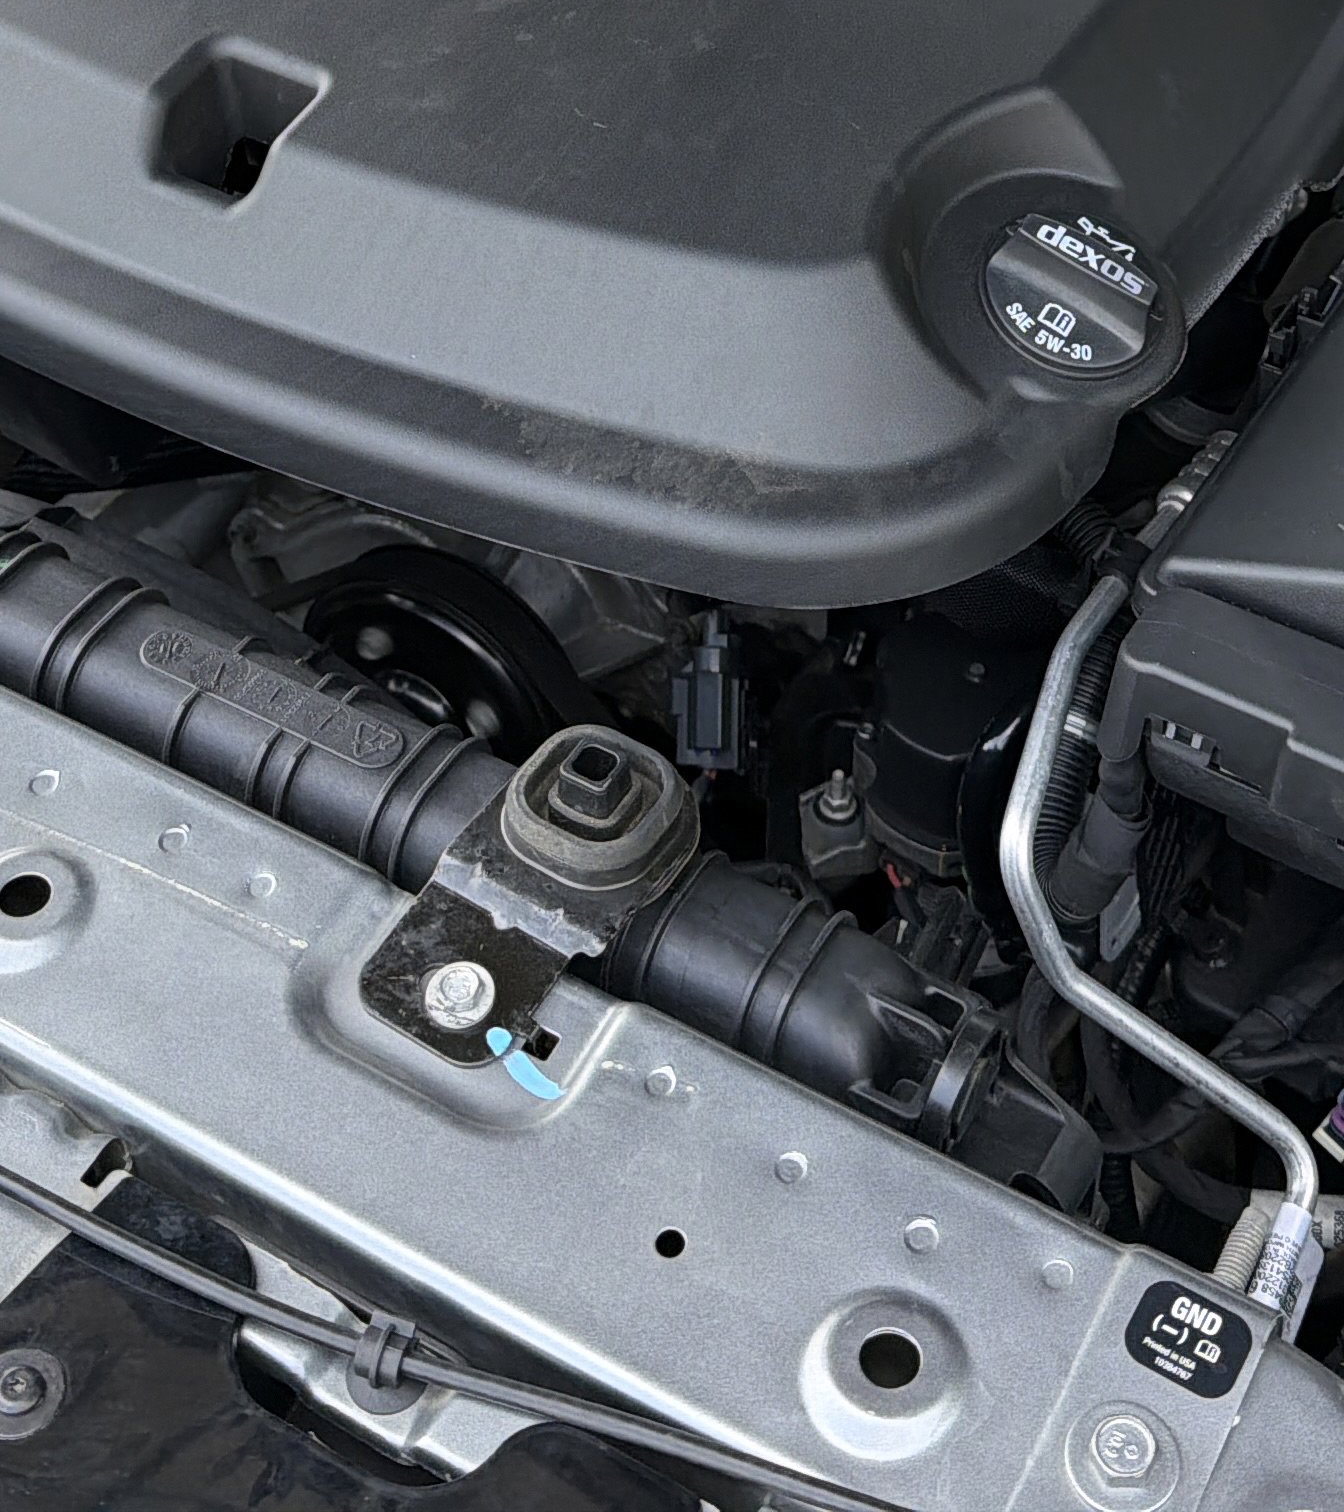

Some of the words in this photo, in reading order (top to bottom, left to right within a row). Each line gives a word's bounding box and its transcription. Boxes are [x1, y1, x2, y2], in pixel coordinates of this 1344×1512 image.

[1036, 224, 1145, 295] dexos
[1006, 302, 1035, 333] SAE
[1034, 329, 1092, 361] 5W-30
[1171, 1296, 1223, 1336] GND
[1141, 1337, 1170, 1358] Printed
[1170, 1351, 1180, 1362] in
[1179, 1354, 1196, 1370] USA
